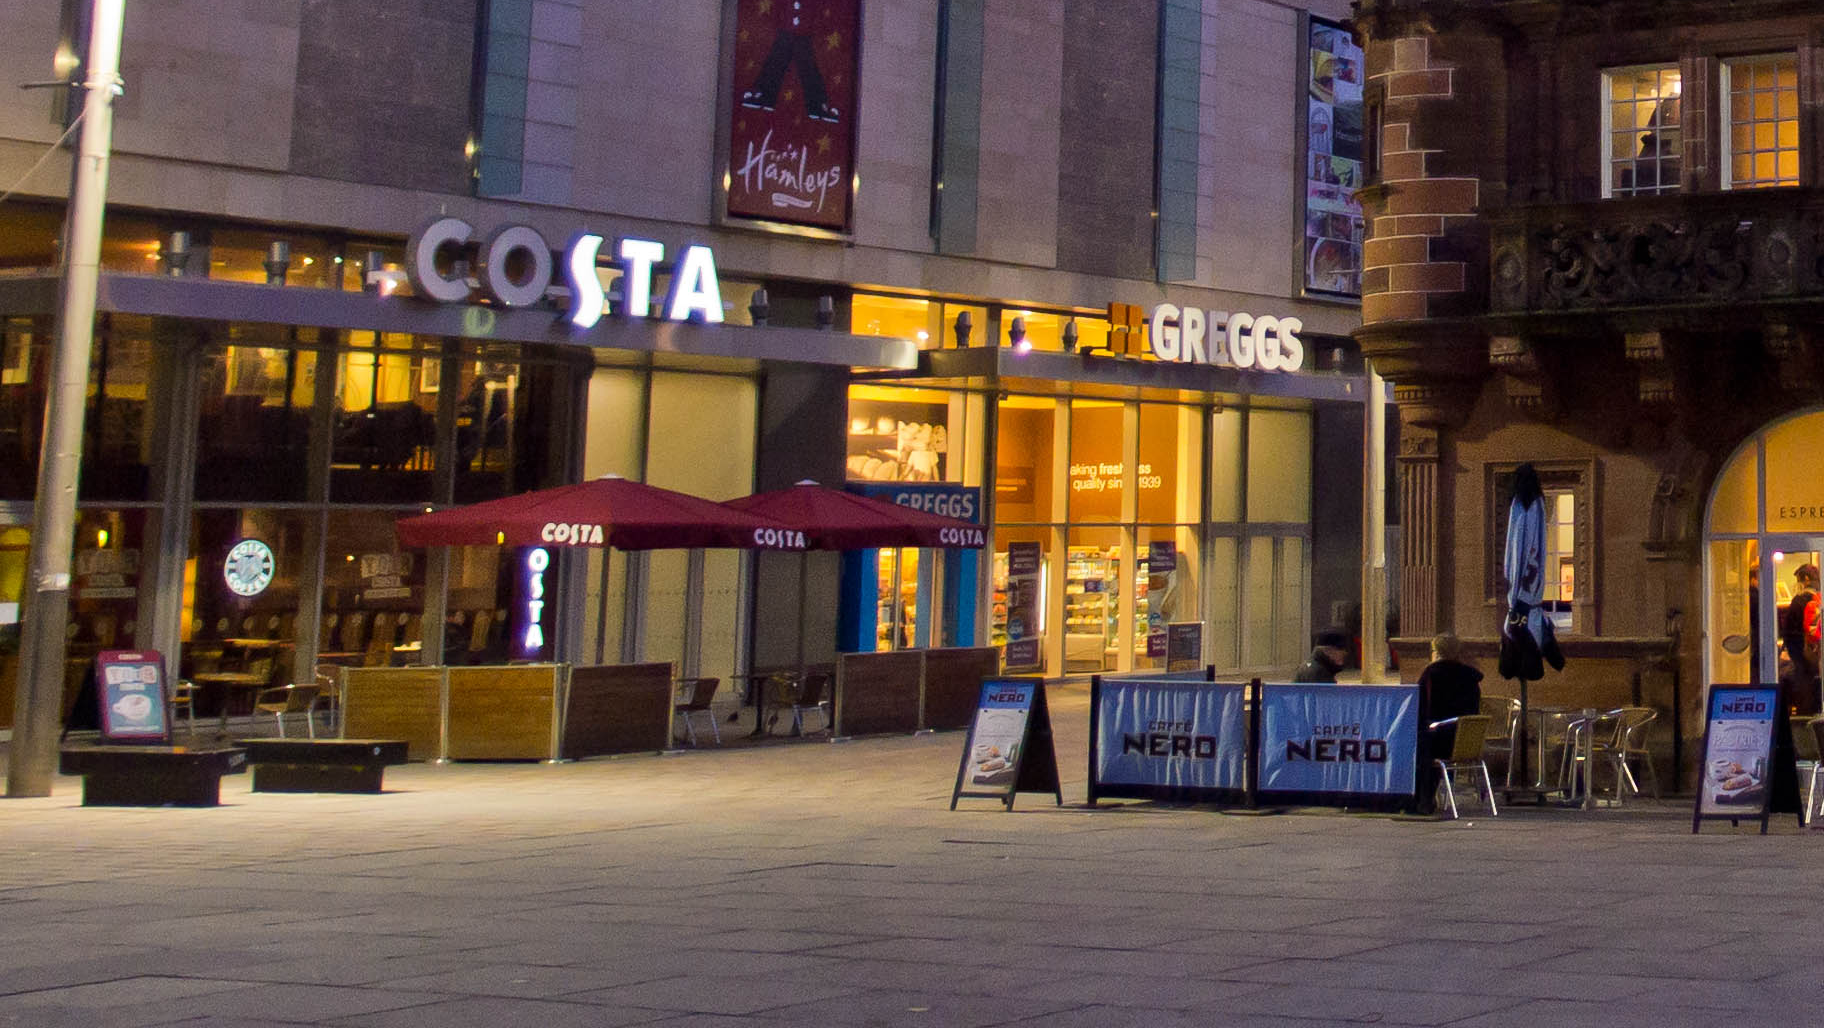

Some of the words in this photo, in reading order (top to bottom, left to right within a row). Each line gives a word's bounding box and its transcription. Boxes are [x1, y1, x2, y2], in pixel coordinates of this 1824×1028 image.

[737, 128, 842, 213] Hamleys
[415, 217, 725, 329] COSTA
[1151, 303, 1305, 373] GREGGS
[1069, 464, 1097, 478] aking
[1138, 475, 1162, 489] 1939
[541, 523, 604, 545] COSTA
[754, 528, 806, 548] COSTA
[939, 528, 985, 546] COSTA
[524, 548, 549, 648] OSTA
[988, 693, 1025, 703] NERO
[1722, 702, 1766, 712] NERO
[1123, 733, 1217, 759] NERO
[1287, 739, 1387, 763] NERO
